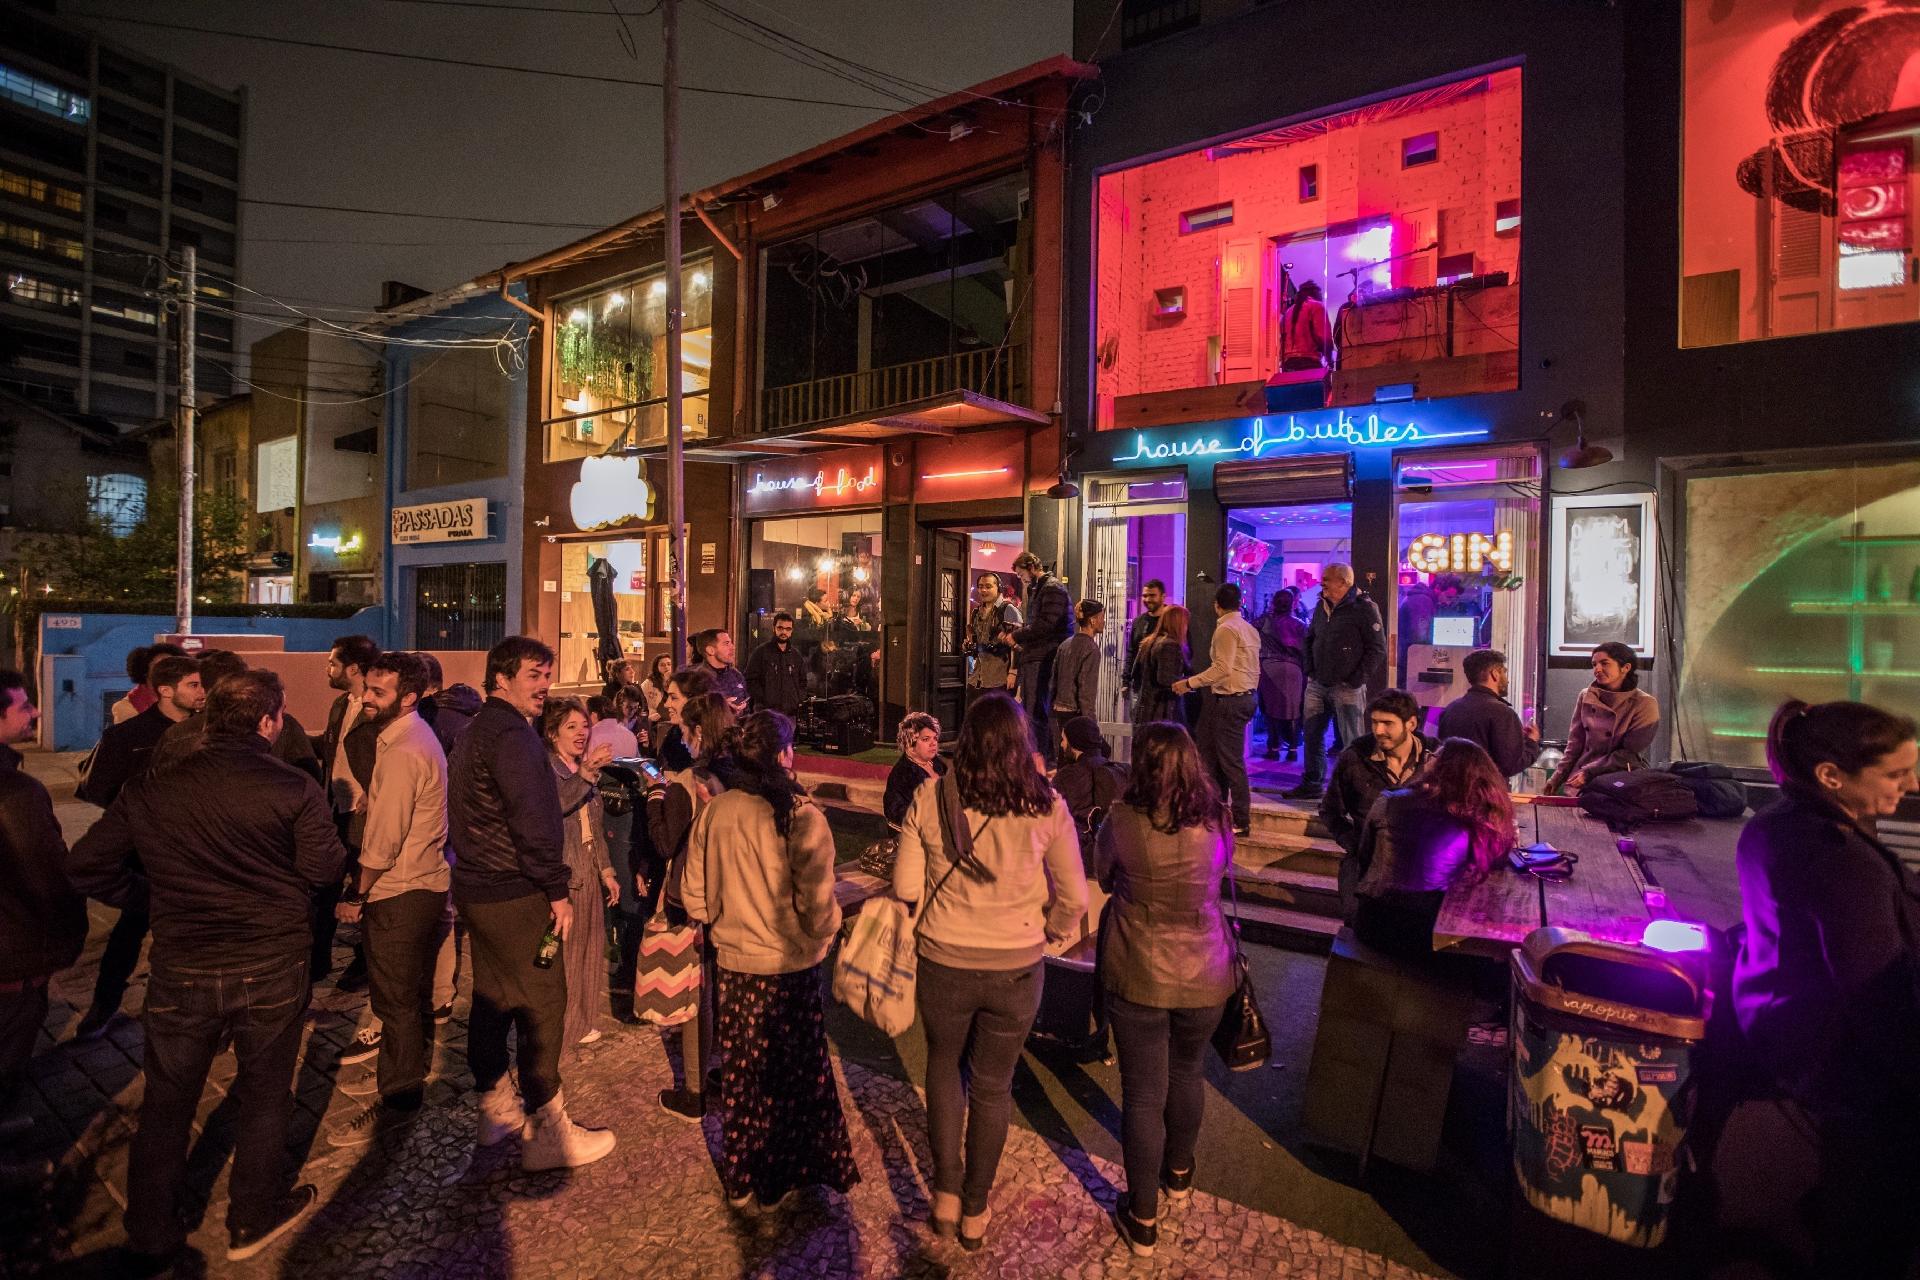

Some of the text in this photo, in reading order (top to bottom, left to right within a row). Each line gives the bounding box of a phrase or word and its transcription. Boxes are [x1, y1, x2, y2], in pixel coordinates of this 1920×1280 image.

[1130, 410, 1420, 460] house of bubbles
[752, 473, 807, 495] house
[837, 466, 876, 496] food
[399, 504, 473, 532] PASSADAS
[448, 529, 473, 538] PRAIA
[1408, 528, 1512, 574] GIN
